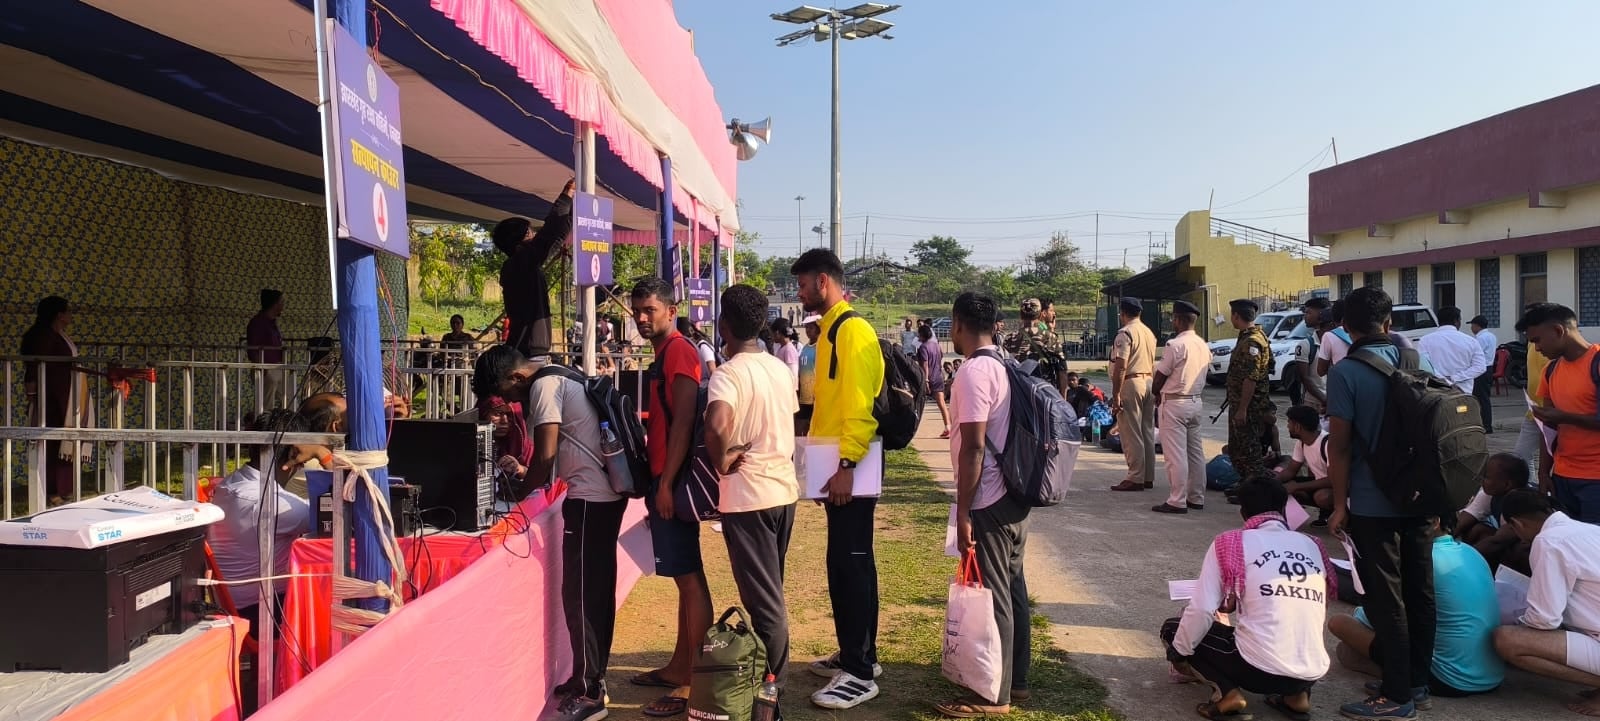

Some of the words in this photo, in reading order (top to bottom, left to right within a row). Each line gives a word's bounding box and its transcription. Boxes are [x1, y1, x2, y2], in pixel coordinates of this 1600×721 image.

[378, 191, 385, 235] 4
[22, 532, 48, 540] STAR
[98, 529, 122, 541] STAR
[1253, 549, 1281, 569] LPL
[1278, 560, 1307, 583] 49
[1259, 583, 1323, 604] SAKIM
